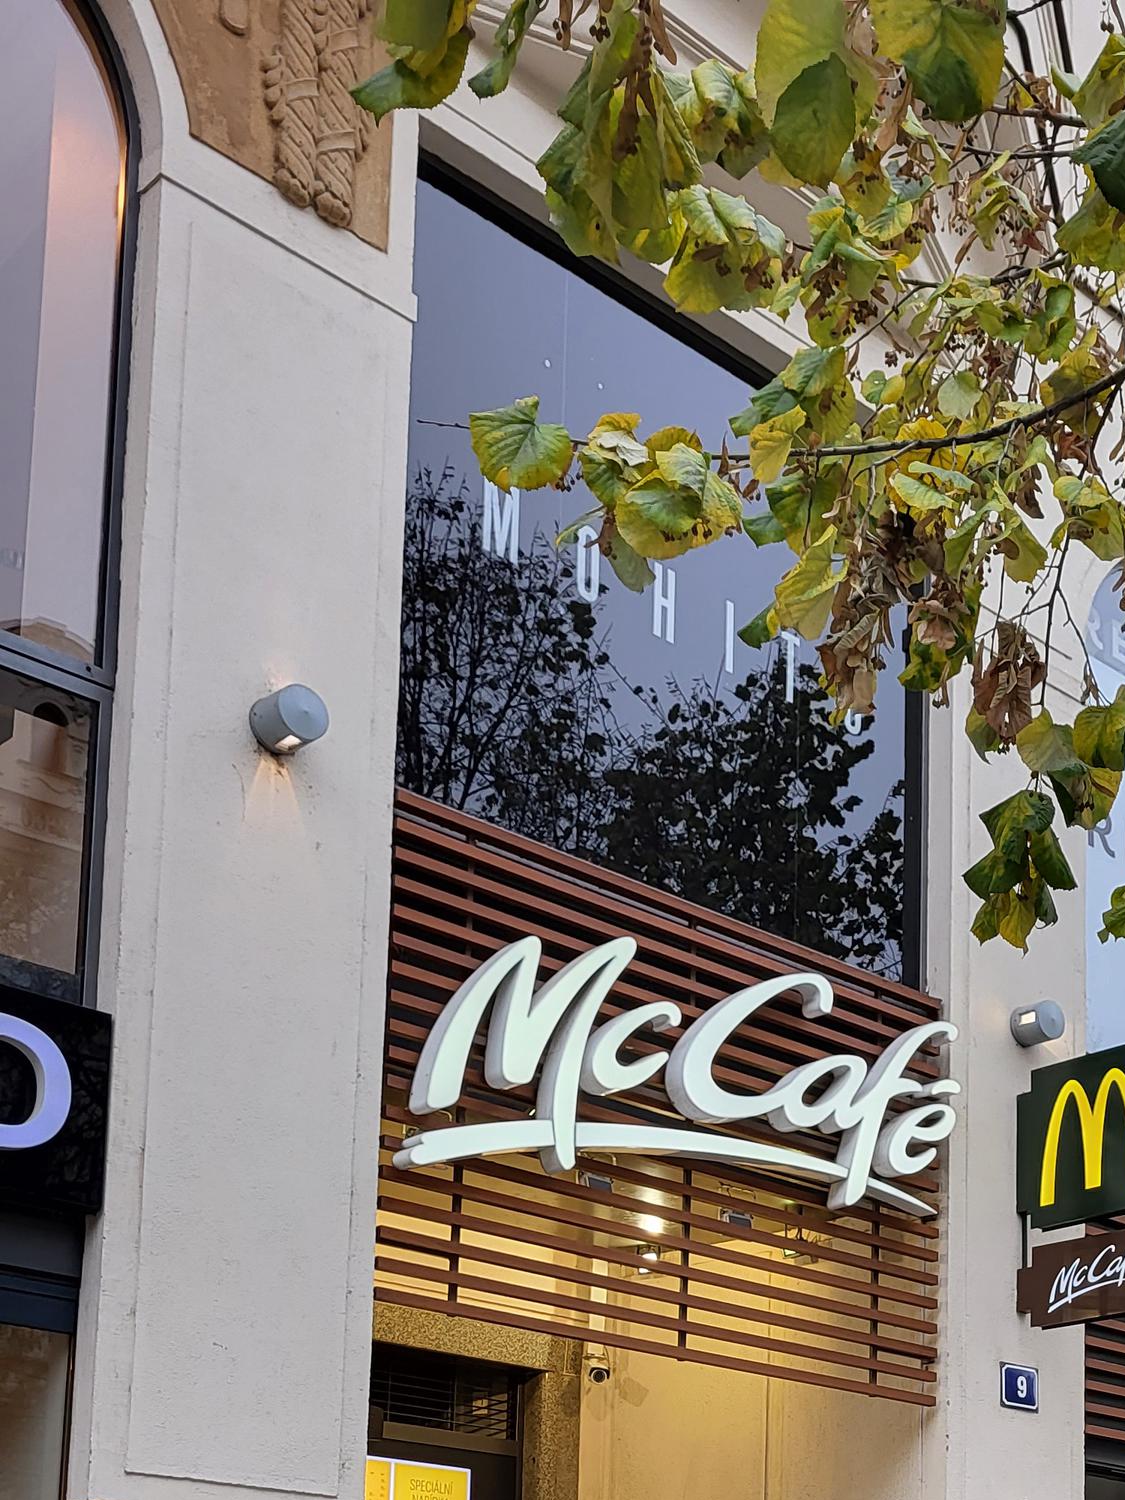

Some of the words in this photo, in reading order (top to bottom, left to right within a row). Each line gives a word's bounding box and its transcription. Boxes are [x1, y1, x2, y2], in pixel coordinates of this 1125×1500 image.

[482, 476, 862, 736] MOHIT
[394, 935, 962, 1214] McCafé
[1016, 1375, 1028, 1399] 9
[409, 1478, 454, 1495] SPECIÁLNÍ
